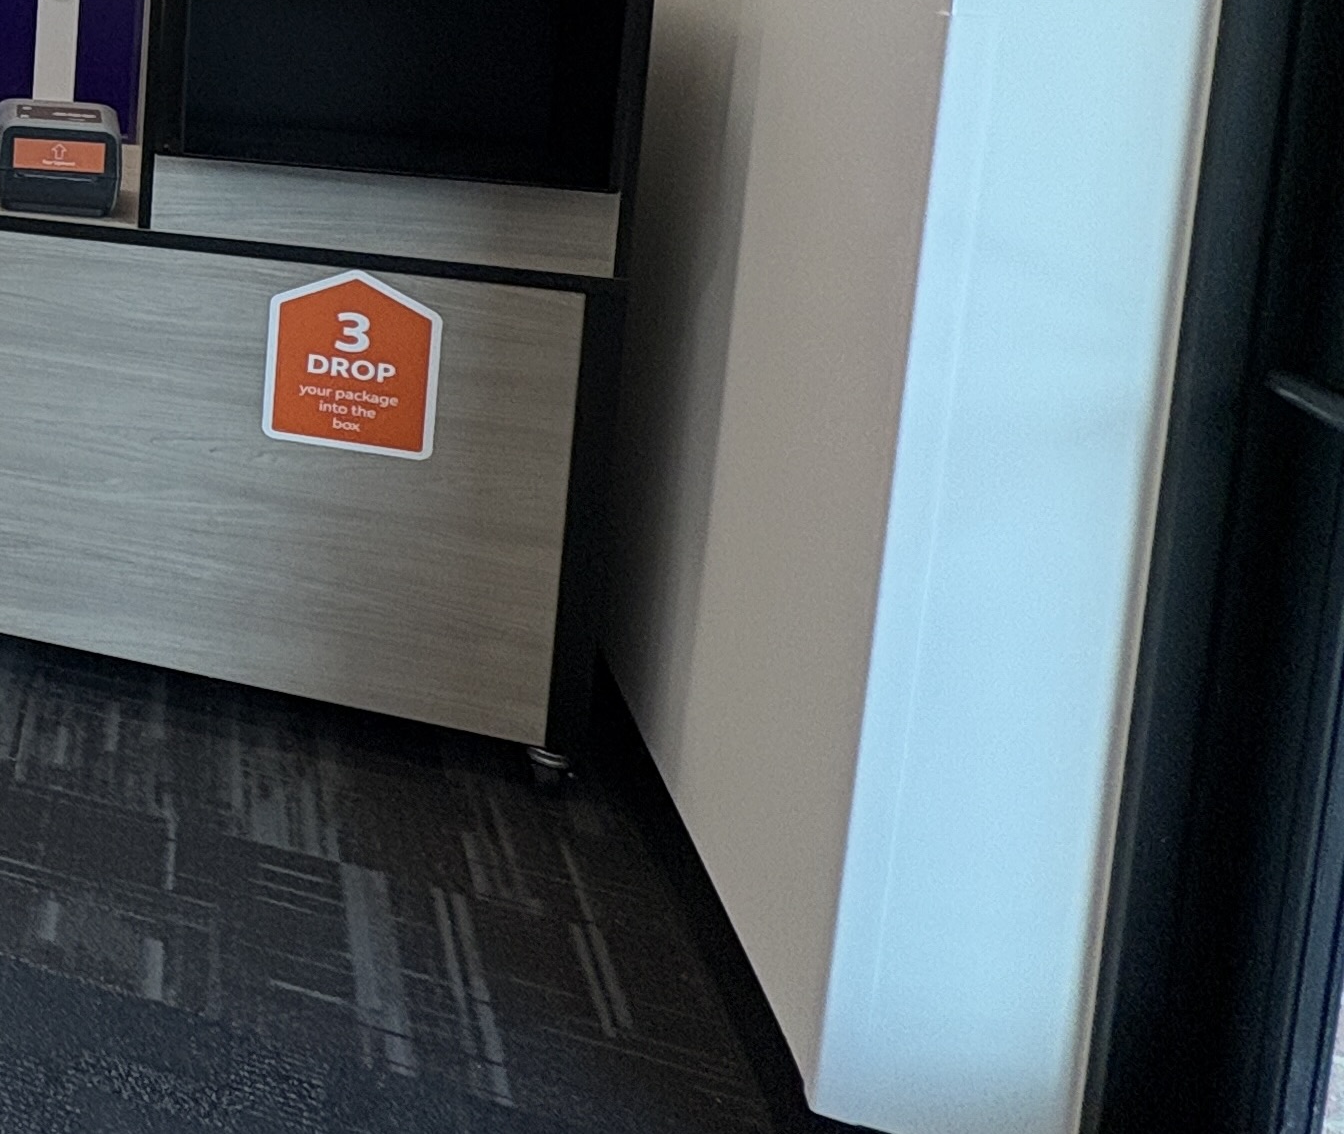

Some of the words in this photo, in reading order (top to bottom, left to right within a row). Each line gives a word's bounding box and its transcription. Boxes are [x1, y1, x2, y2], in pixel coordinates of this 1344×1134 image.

[334, 311, 371, 353] 3
[307, 353, 396, 383] DROP
[299, 384, 332, 396] your
[335, 389, 399, 407] package
[319, 401, 348, 414] into
[351, 405, 376, 419] the
[332, 418, 361, 432] box
